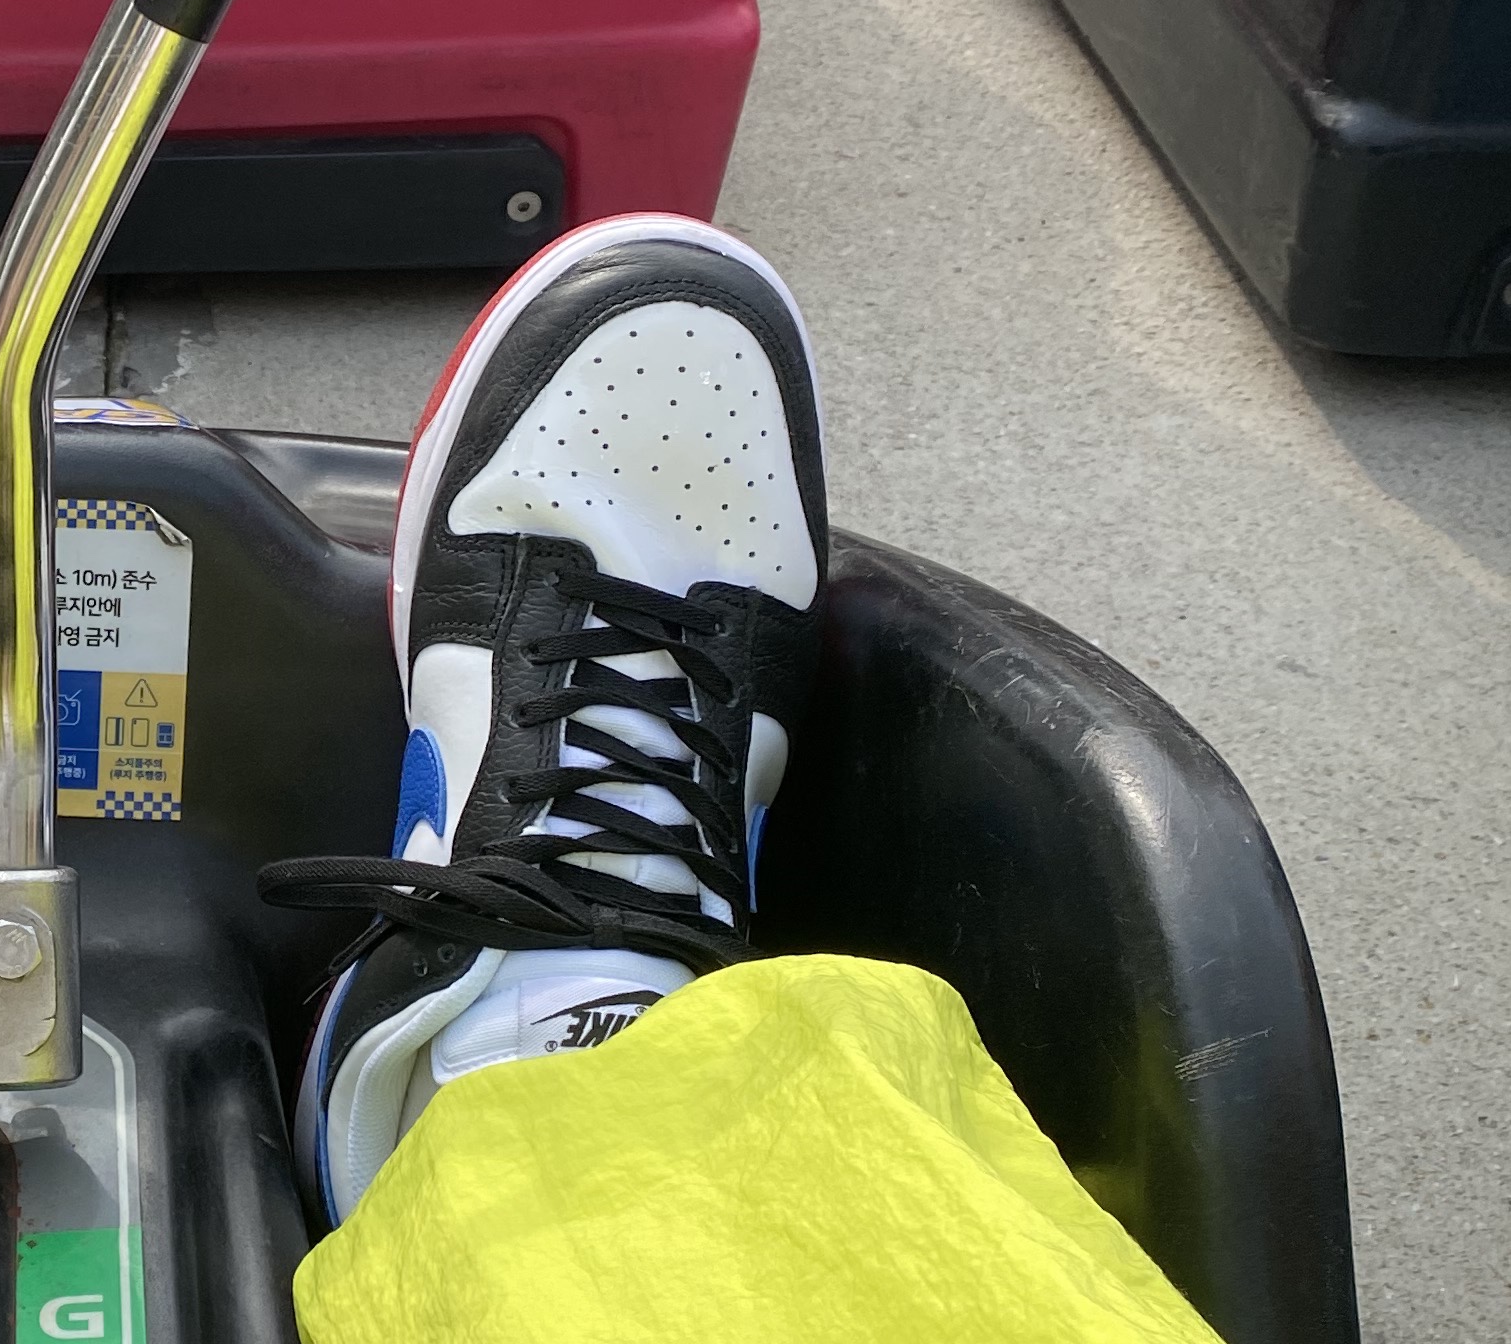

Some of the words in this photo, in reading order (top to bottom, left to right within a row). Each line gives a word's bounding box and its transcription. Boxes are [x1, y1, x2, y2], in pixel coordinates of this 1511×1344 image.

[72, 568, 117, 589] 10m)
[121, 570, 157, 590] 준수
[86, 627, 120, 648] 금지
